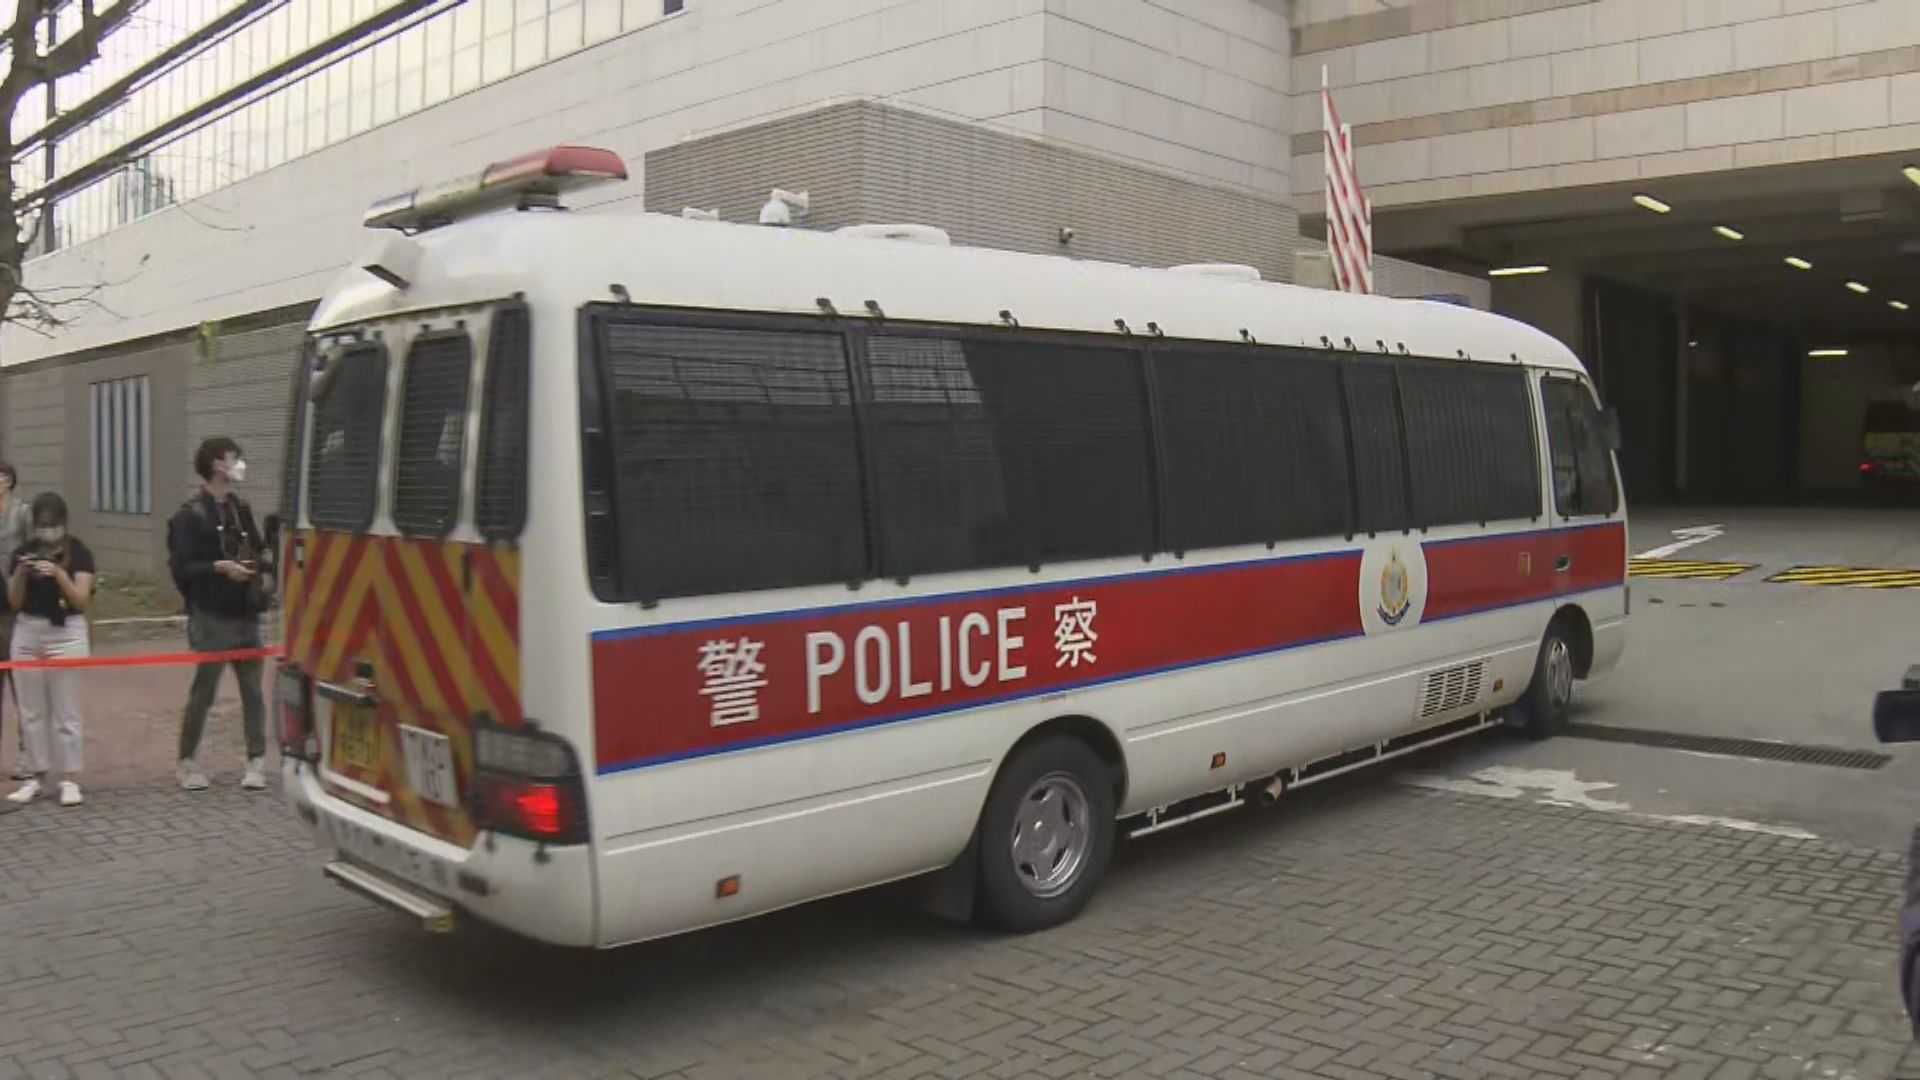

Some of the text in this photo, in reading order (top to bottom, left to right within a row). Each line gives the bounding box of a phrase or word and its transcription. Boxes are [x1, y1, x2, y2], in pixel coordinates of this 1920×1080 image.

[697, 595, 1098, 727] 警 POLICE 察
